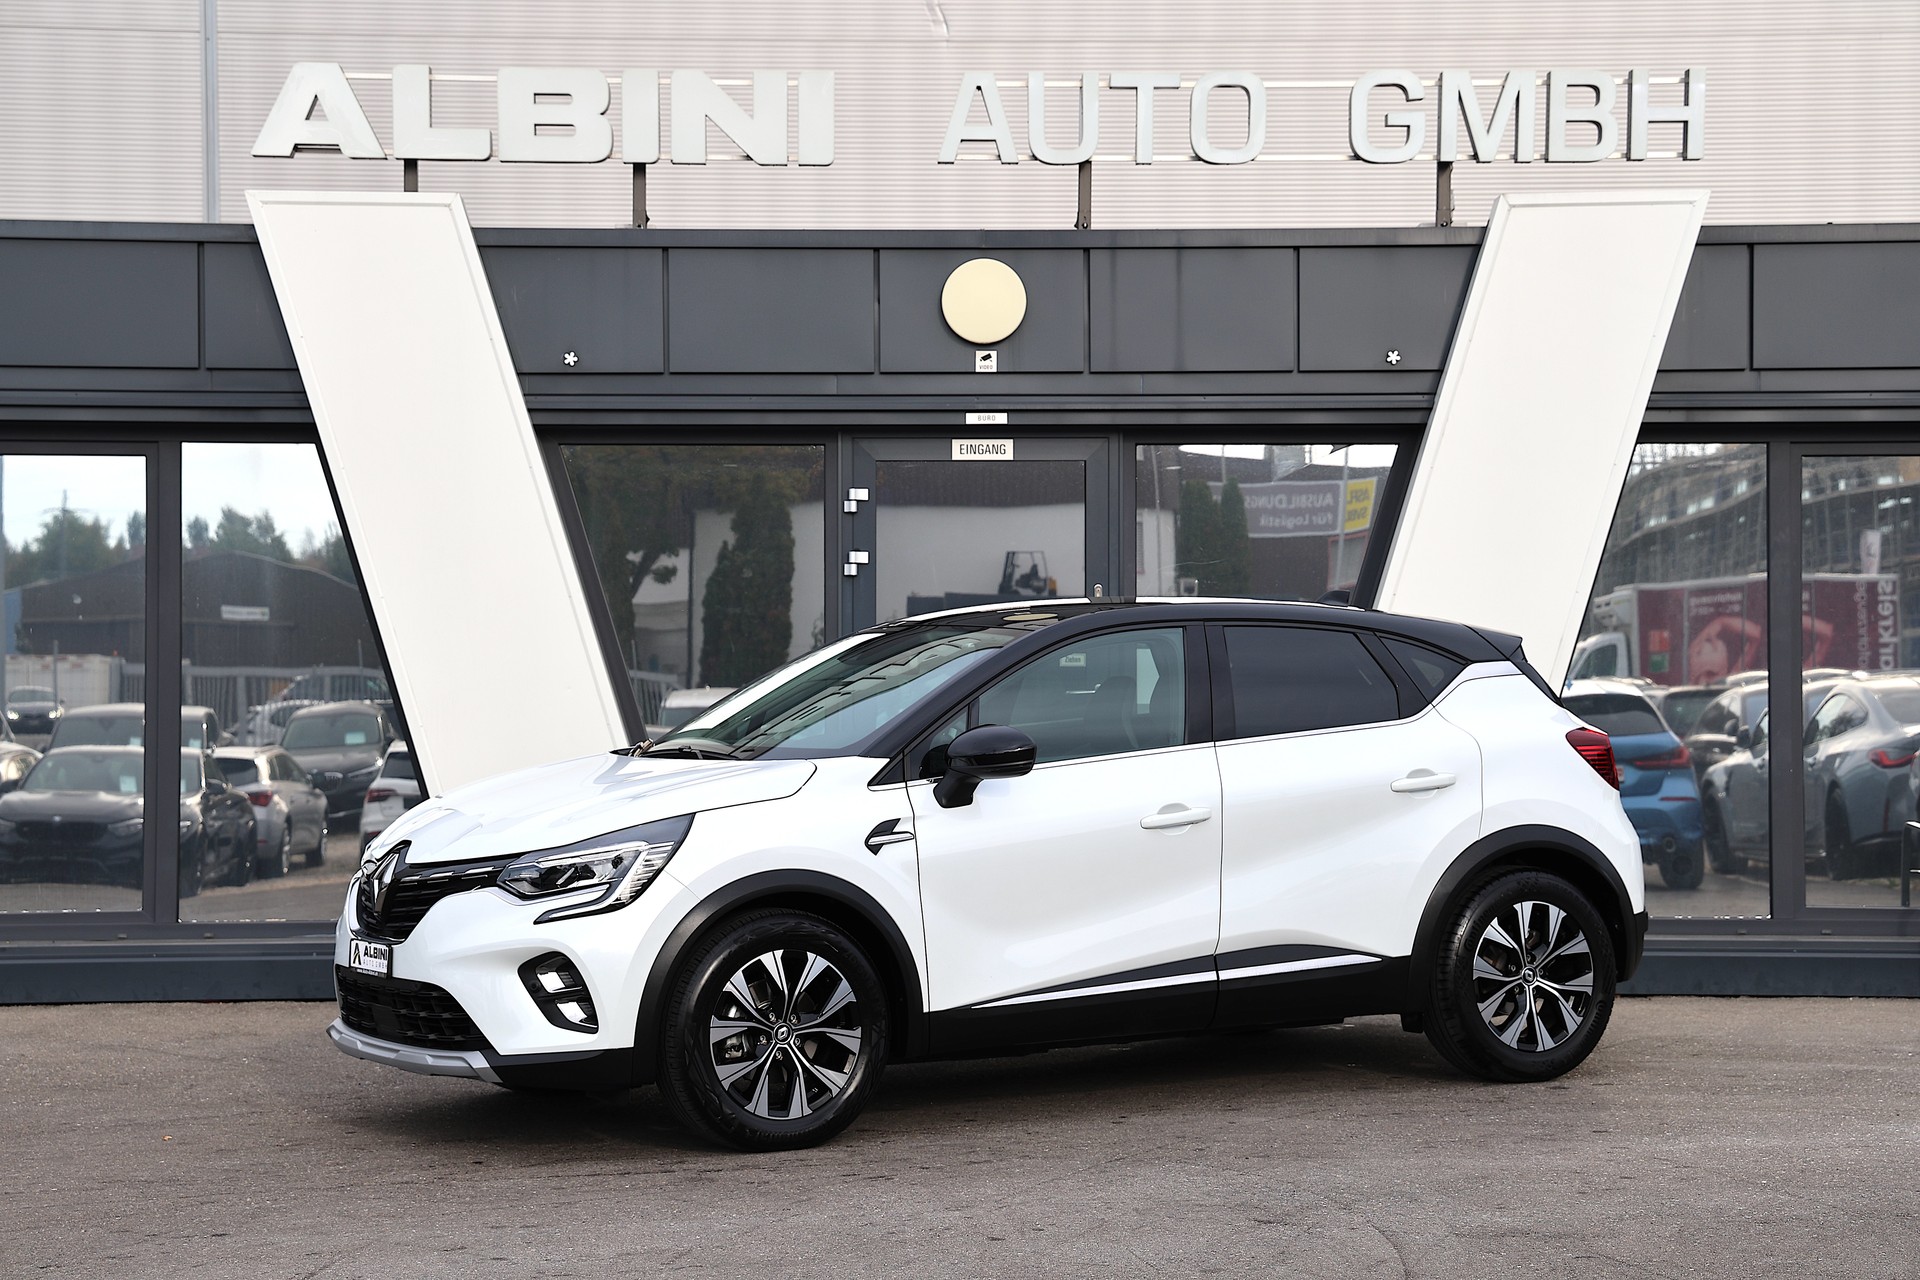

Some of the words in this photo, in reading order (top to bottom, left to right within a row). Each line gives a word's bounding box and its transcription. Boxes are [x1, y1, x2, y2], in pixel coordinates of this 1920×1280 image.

[251, 62, 835, 166] ALBINI
[937, 70, 1267, 165] AUTO
[1349, 67, 1707, 164] GMBH
[959, 443, 1007, 455] EINGANG
[364, 946, 387, 960] ALBINI
